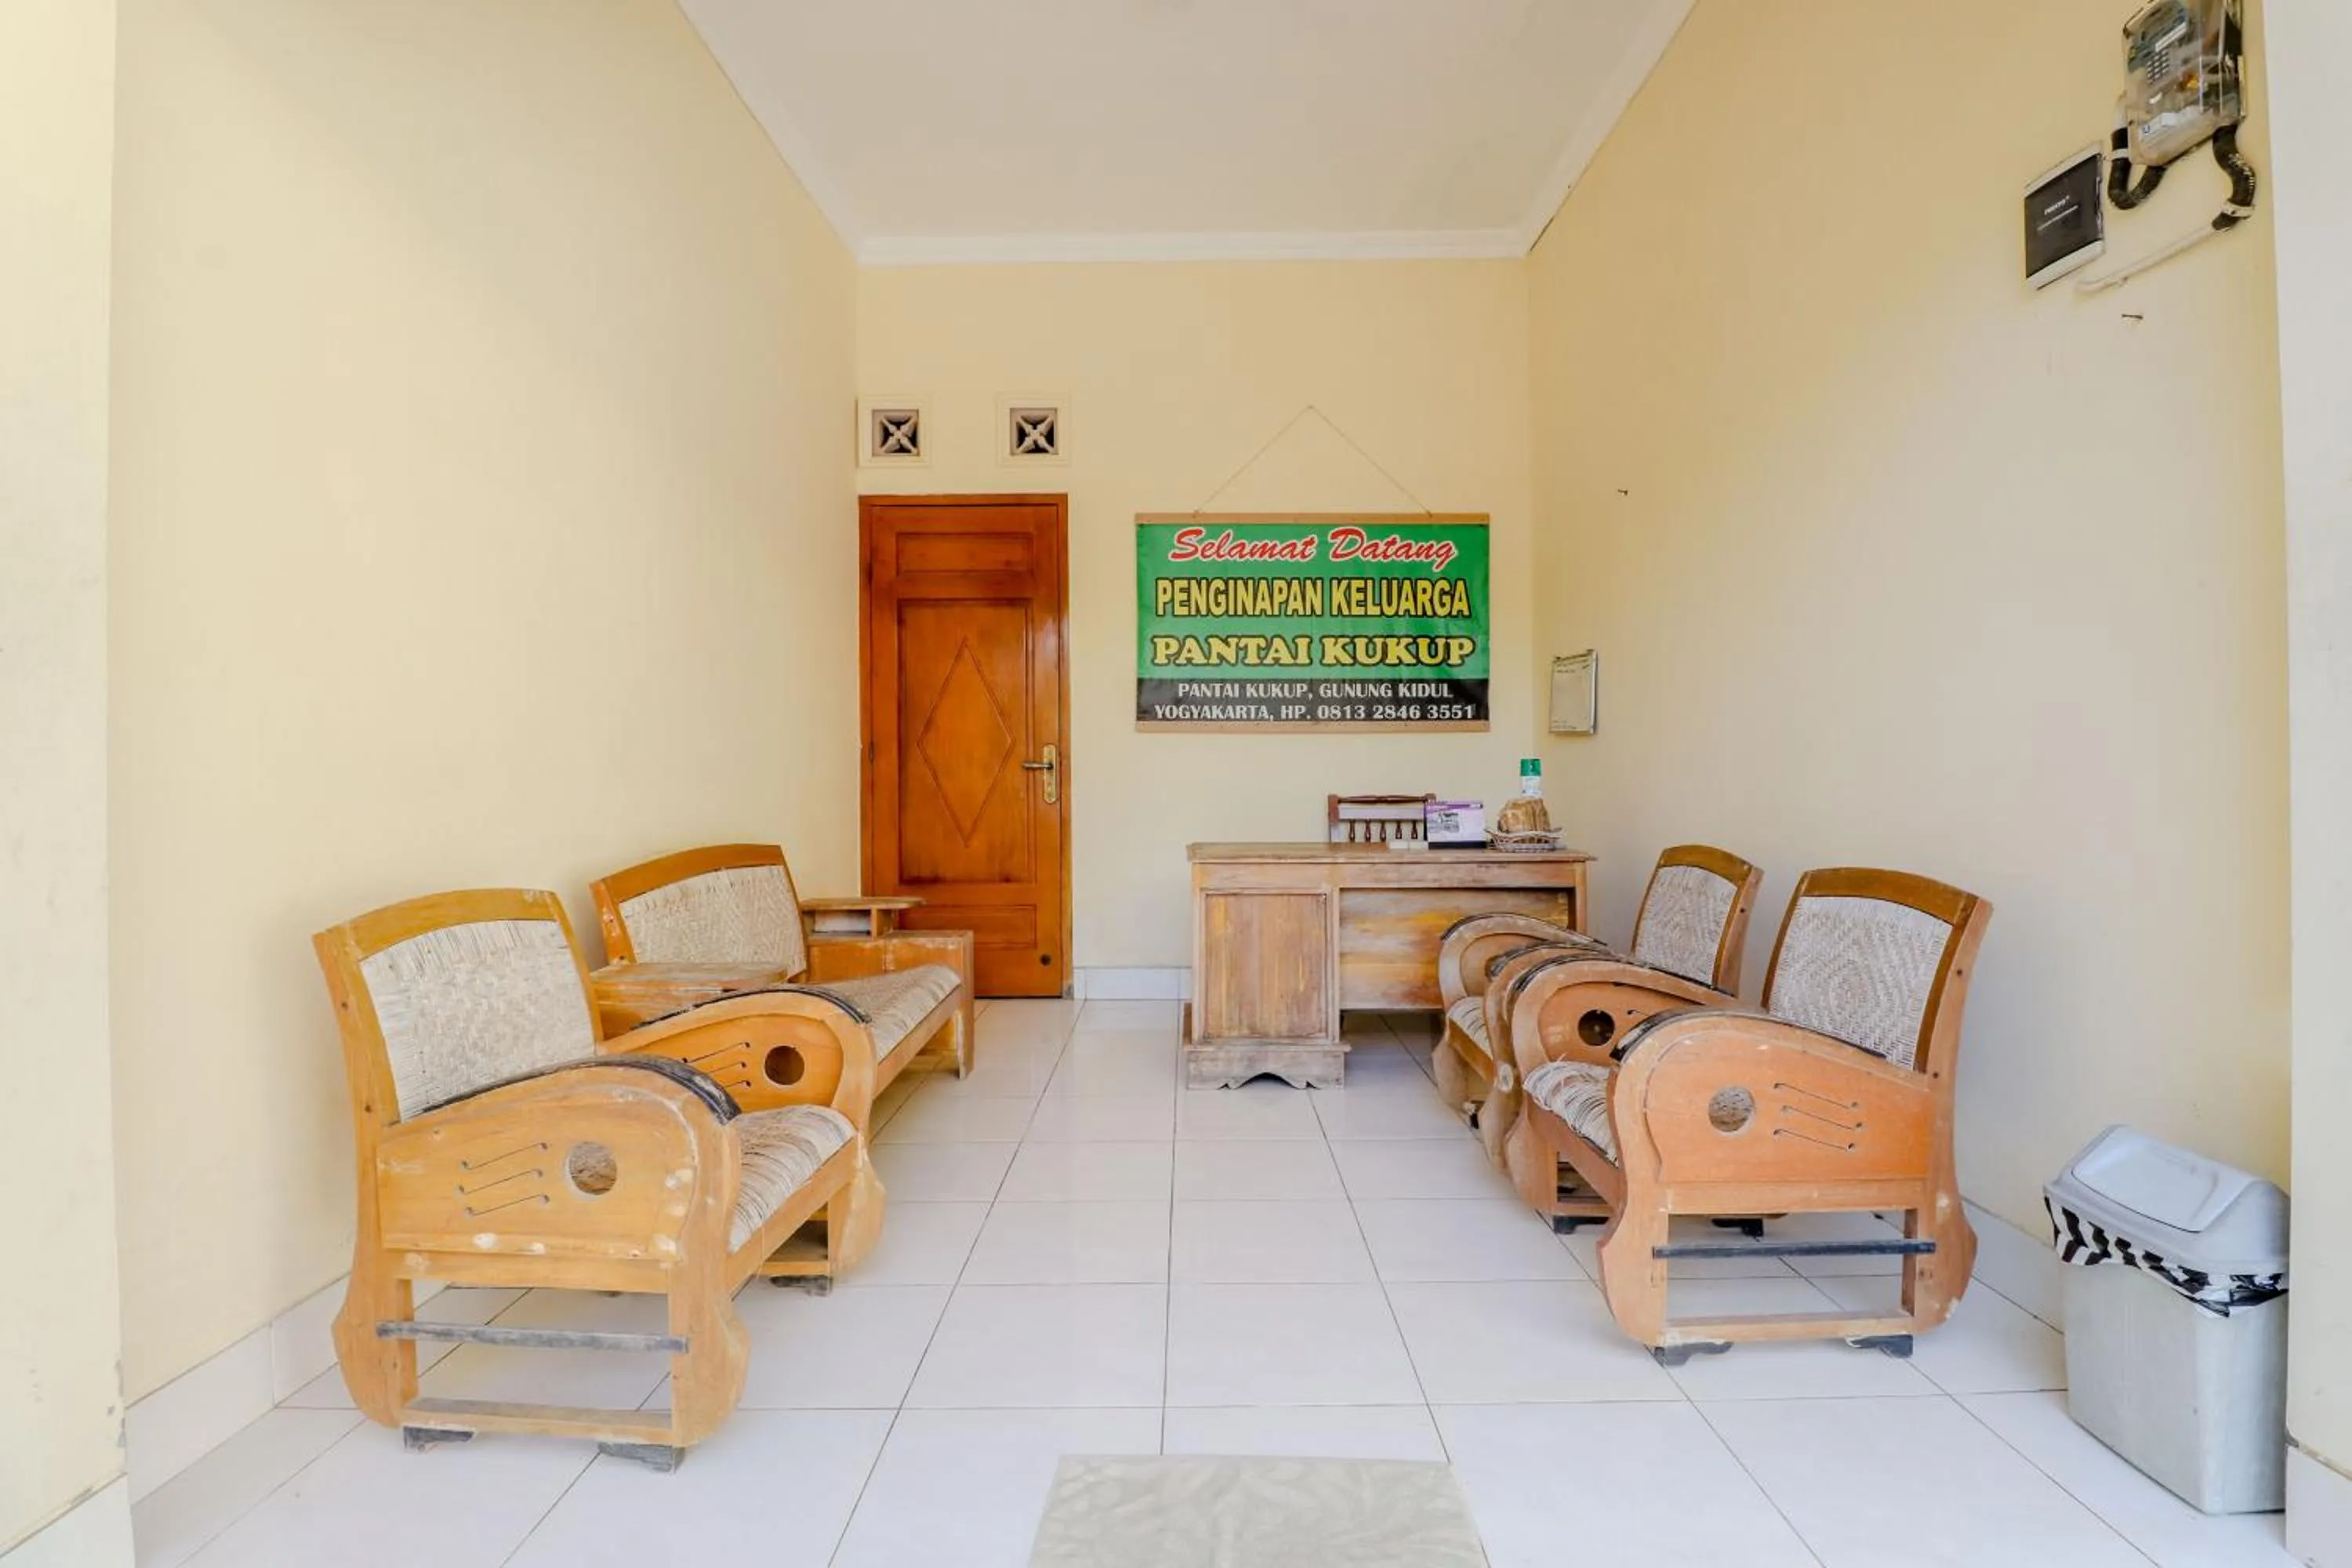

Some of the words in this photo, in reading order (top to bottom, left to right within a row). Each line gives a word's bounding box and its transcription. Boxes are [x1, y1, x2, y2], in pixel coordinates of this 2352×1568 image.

[1168, 527, 1317, 561] Selamat
[1328, 527, 1457, 571] Datang
[1155, 577, 1323, 617] PENGINAPAN
[1330, 577, 1472, 617] KELUARGA
[1151, 634, 1312, 666] PANTAI
[1319, 634, 1475, 666] KUKUP
[1178, 683, 1240, 699] PANTAI
[1245, 683, 1312, 700] KUKUP,
[1319, 683, 1393, 699] GUNUNG
[1398, 683, 1454, 699] KIDUL
[1154, 705, 1275, 721] YOGYAKARTA,
[1280, 705, 1311, 720] HP.
[1317, 705, 1366, 720] 0813
[1372, 705, 1421, 720] 2846
[1427, 705, 1474, 720] 3551
